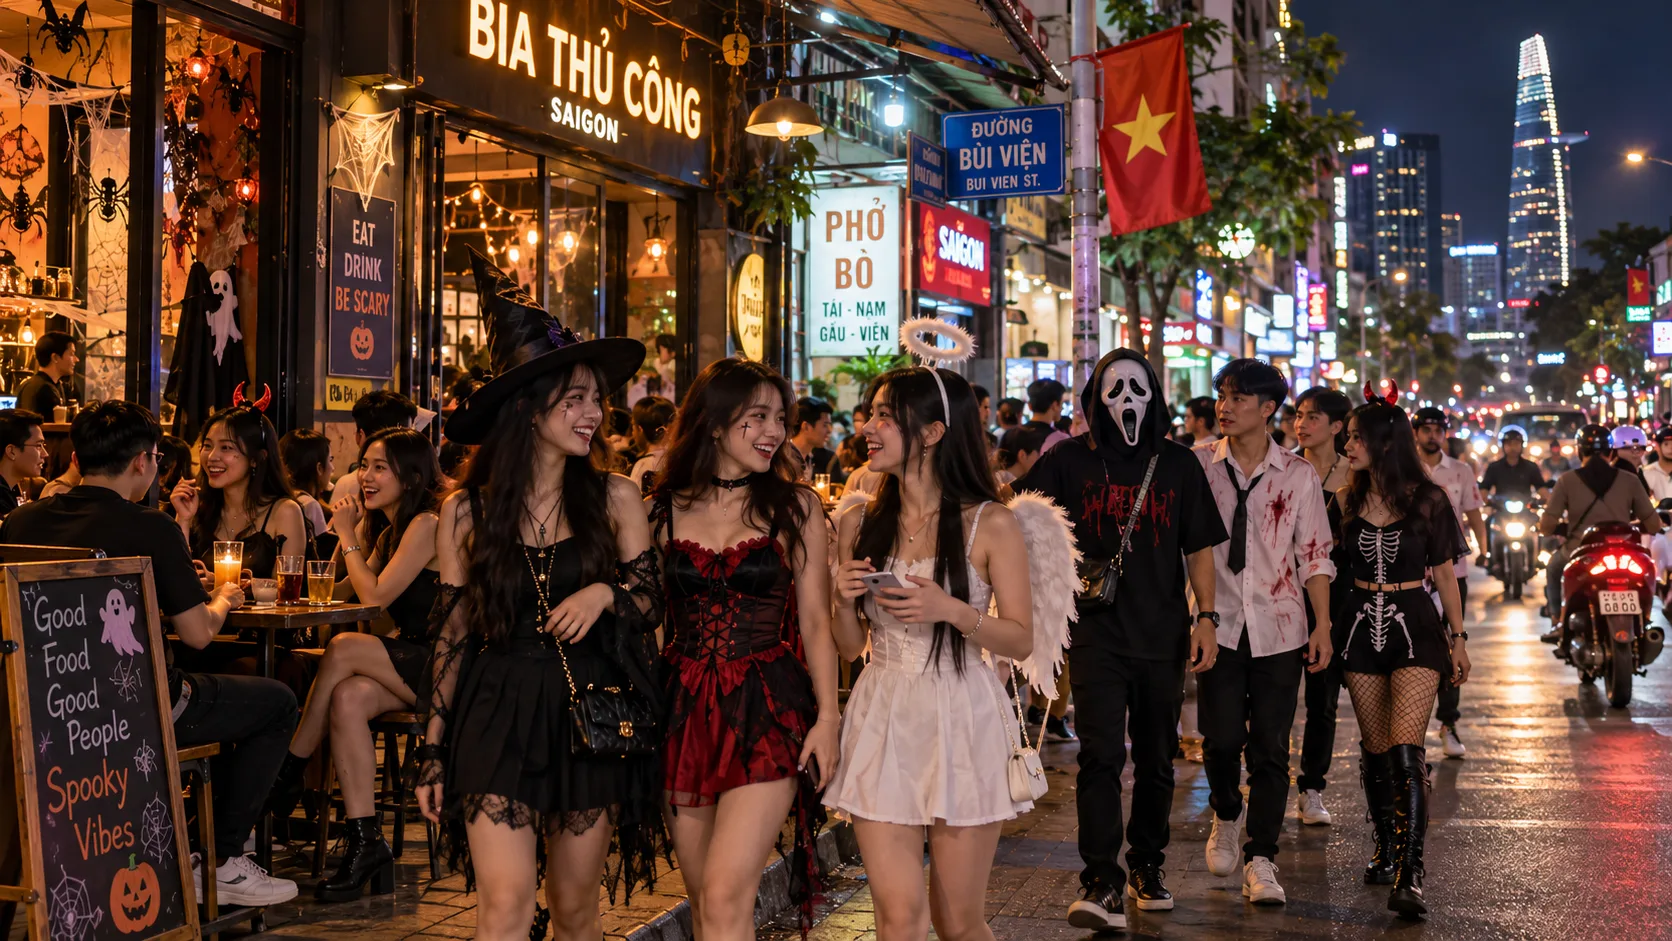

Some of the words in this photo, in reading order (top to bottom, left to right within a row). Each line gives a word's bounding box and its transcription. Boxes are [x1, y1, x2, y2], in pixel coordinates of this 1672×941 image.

[469, 0, 537, 78] BIA
[547, 27, 614, 105] THỦ
[623, 55, 702, 140] CÔNG
[550, 96, 619, 143] SAIGON
[971, 115, 1033, 138] ĐƯỜNG
[959, 141, 992, 171] BÙI
[999, 139, 1047, 171] VIỆN
[966, 177, 986, 191] BUI
[991, 175, 1018, 189] VIEN
[1023, 174, 1041, 187] ST.
[352, 219, 376, 247] EAT
[825, 197, 887, 242] PHỞ
[835, 249, 873, 289] BÒ
[938, 225, 985, 272] SAIGON
[335, 286, 351, 312] BE
[353, 288, 391, 317] SCARY
[822, 298, 842, 317] TÁI
[34, 593, 87, 636] Good
[42, 638, 91, 678] Food
[47, 677, 100, 720] Good
[66, 709, 131, 756] People
[47, 758, 129, 820] Spooky
[74, 814, 135, 861] Vibes
